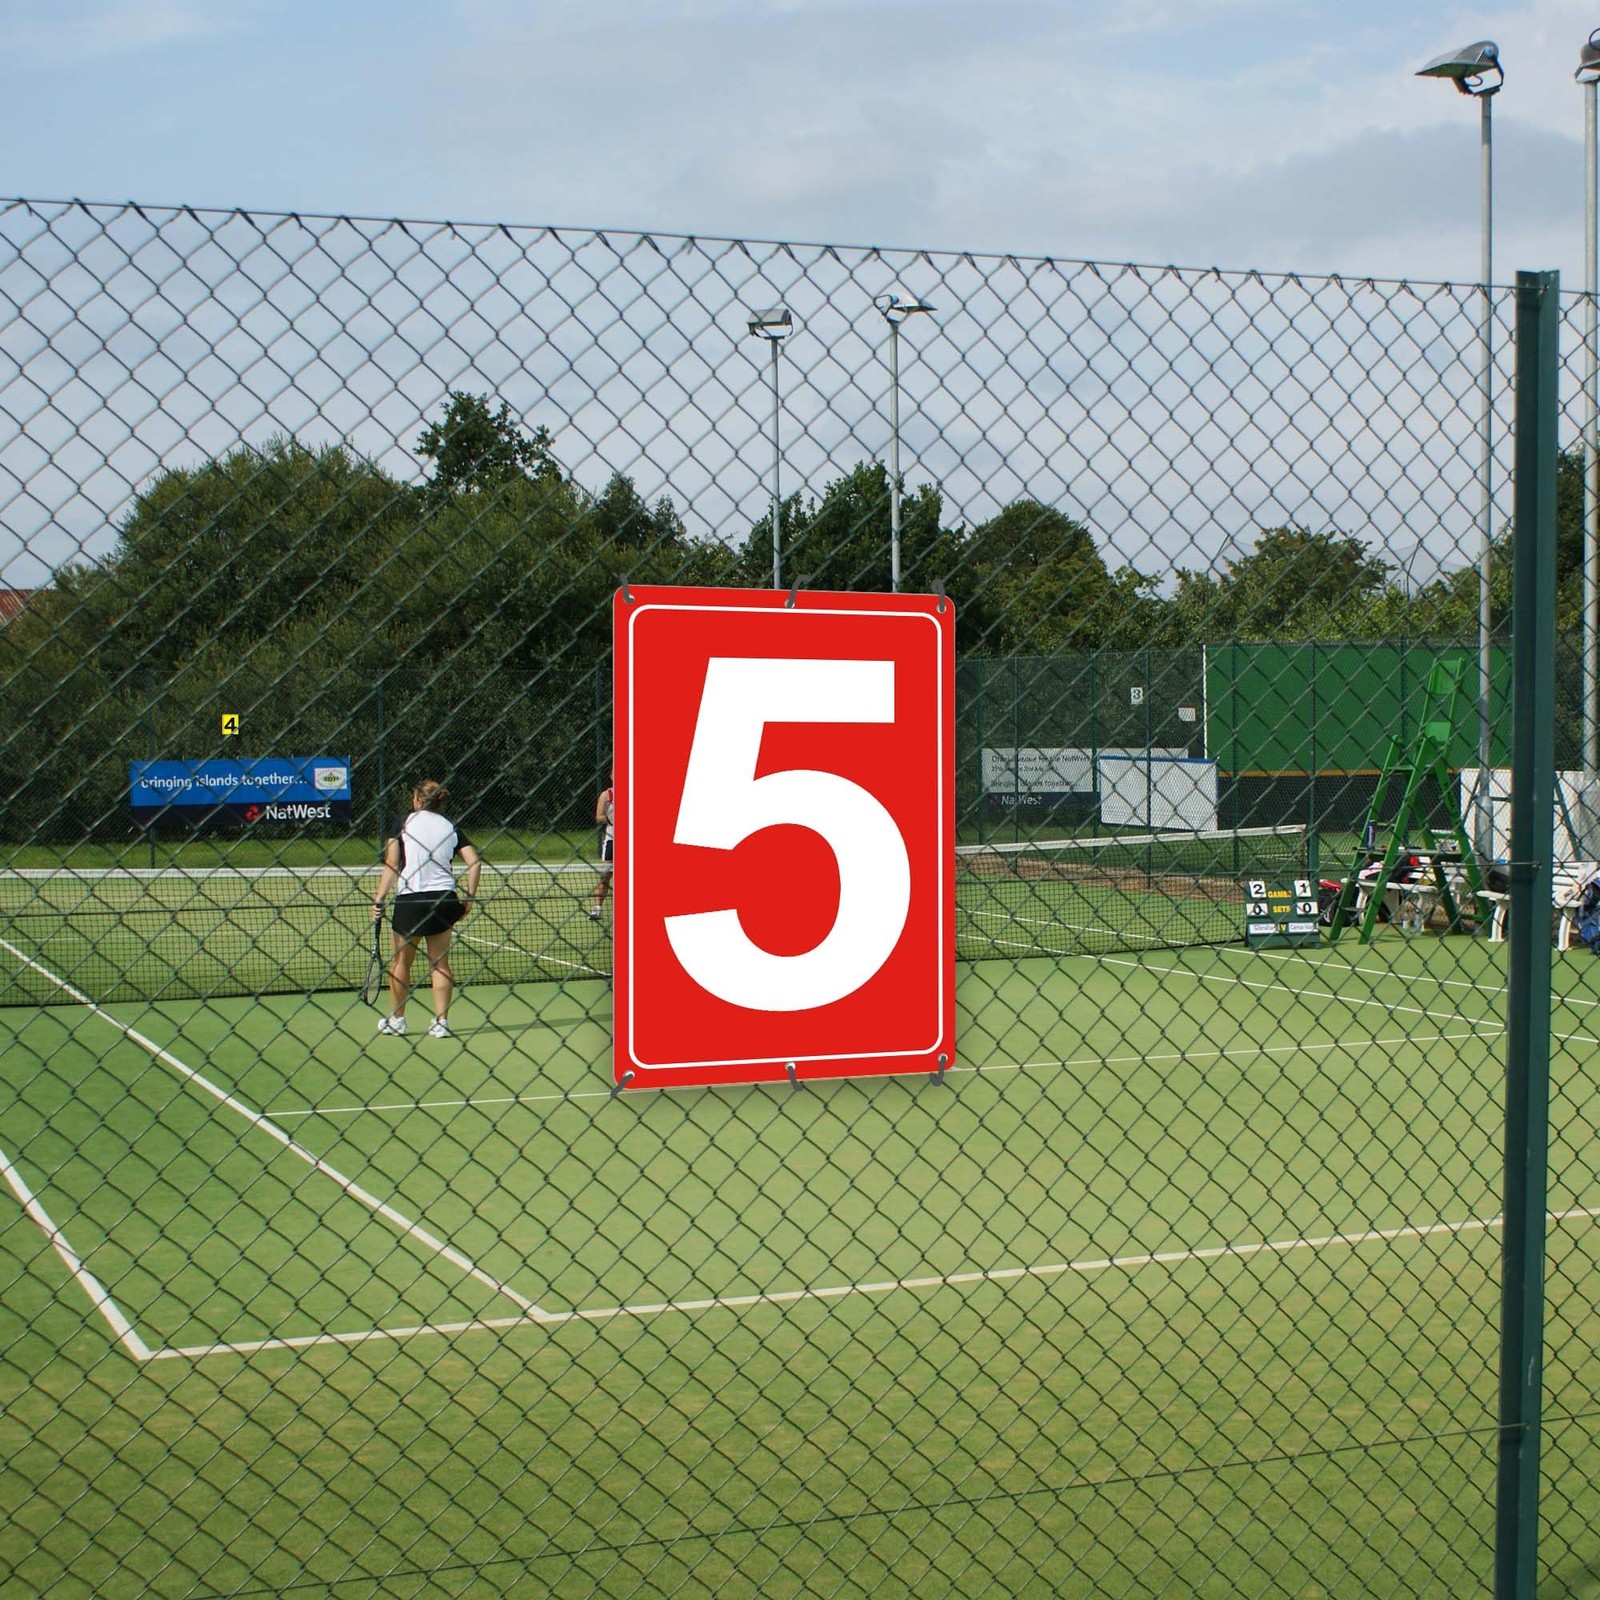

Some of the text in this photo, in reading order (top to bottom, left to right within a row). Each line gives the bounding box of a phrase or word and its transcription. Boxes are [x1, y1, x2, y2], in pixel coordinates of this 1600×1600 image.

[1132, 689, 1141, 700] 3
[224, 717, 238, 732] 4
[141, 776, 193, 791] bringing
[196, 774, 239, 787] islands
[1001, 795, 1042, 806] NaWest
[265, 804, 332, 820] NatWest
[664, 657, 911, 1012] 5
[1253, 884, 1264, 895] 2
[1300, 883, 1308, 893] 1
[1253, 903, 1262, 915] 0
[1303, 903, 1312, 914] 0
[1280, 923, 1287, 931] V
